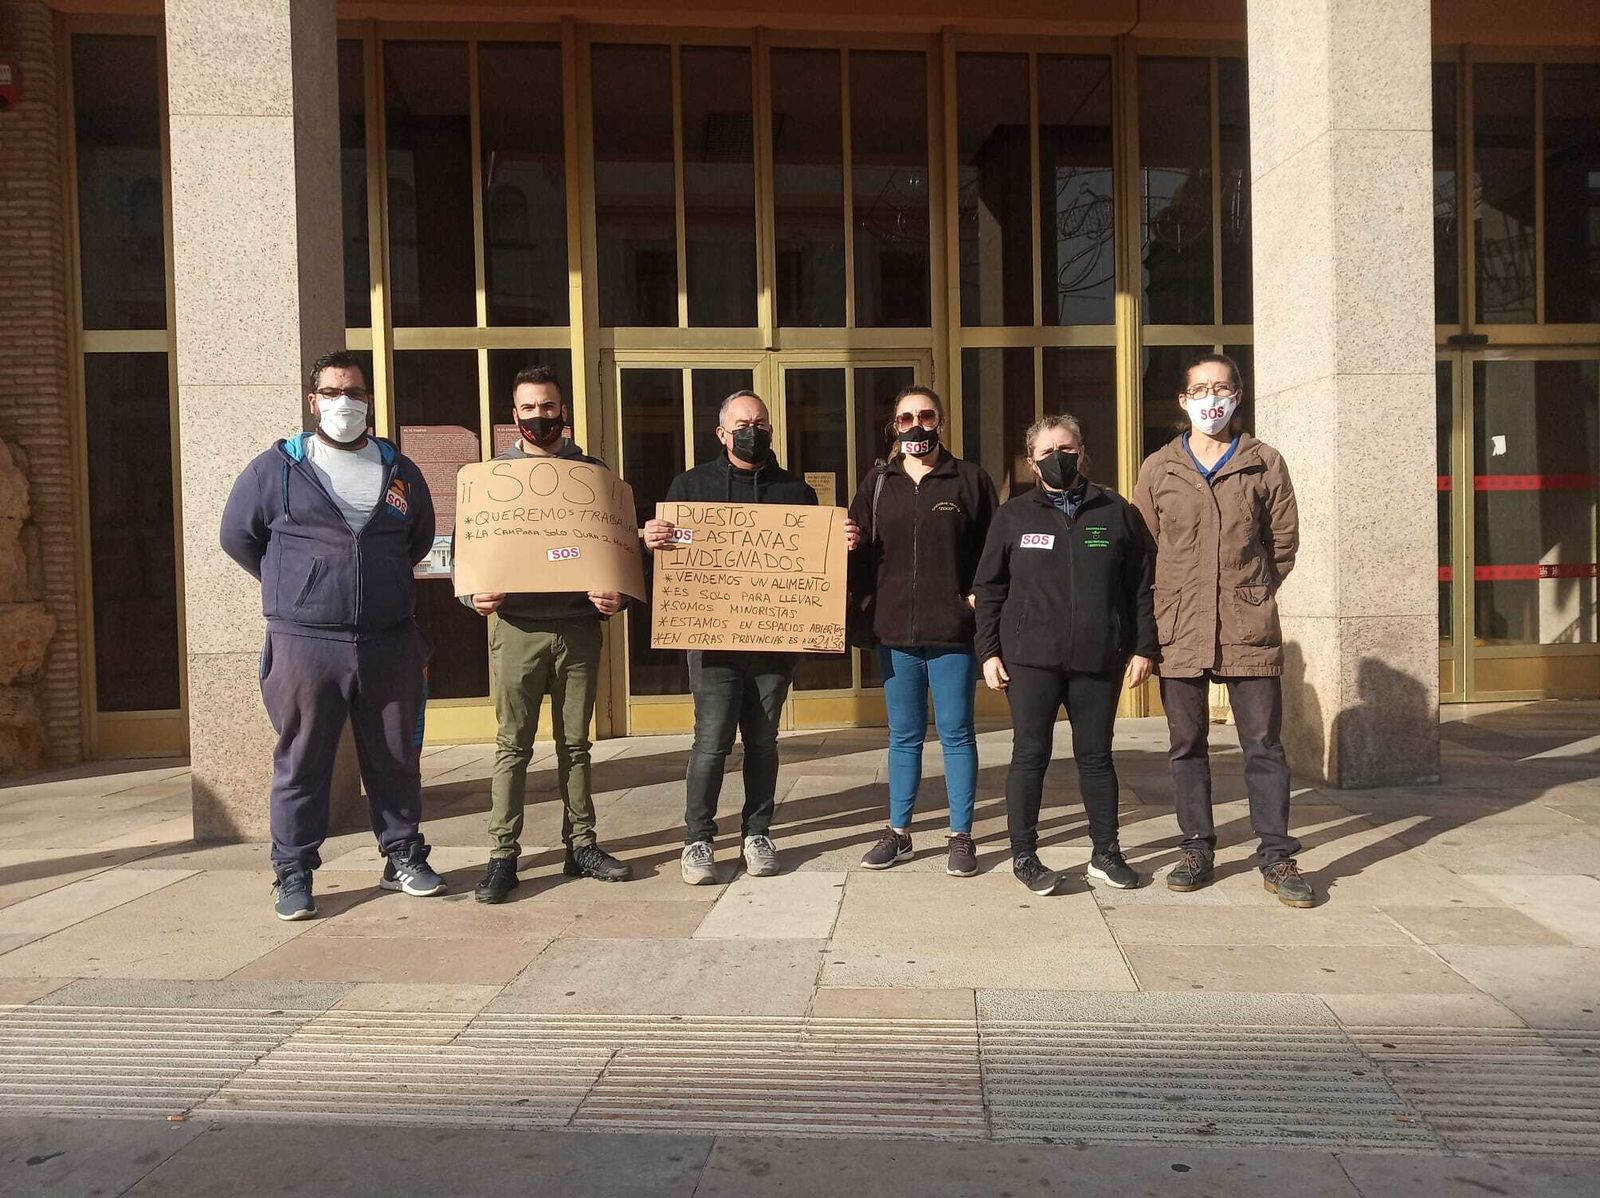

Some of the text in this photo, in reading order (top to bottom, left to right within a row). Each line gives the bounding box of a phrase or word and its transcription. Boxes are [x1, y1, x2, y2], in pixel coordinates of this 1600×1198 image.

[1200, 406, 1225, 420] SOS
[905, 441, 928, 453] SOS
[487, 462, 596, 505] SOS
[388, 493, 407, 512] SOS
[474, 507, 574, 526] QUEREMOS
[676, 504, 808, 528] PUESTOS DE
[475, 529, 489, 539] LA
[543, 529, 567, 537] SOLO
[572, 528, 599, 540] DURA
[602, 535, 611, 544] 2
[692, 529, 800, 551] CASTAÑAS
[1022, 535, 1050, 545] SOS
[551, 546, 579, 560] SOS
[669, 547, 806, 572] INDIGNADOS
[676, 571, 831, 592] VENDEMOS UN ALIMENTO
[674, 587, 823, 607] ES SOLO PARA LLEVAR
[670, 601, 798, 619] SOMOS MINORISTAS
[670, 616, 845, 637] ESTAMOS EN ESPACIOS ABIERTOS
[663, 632, 680, 645] EN
[688, 633, 724, 644] OTRAS
[732, 634, 785, 645] PROVINCIAS
[788, 636, 798, 645] ES
